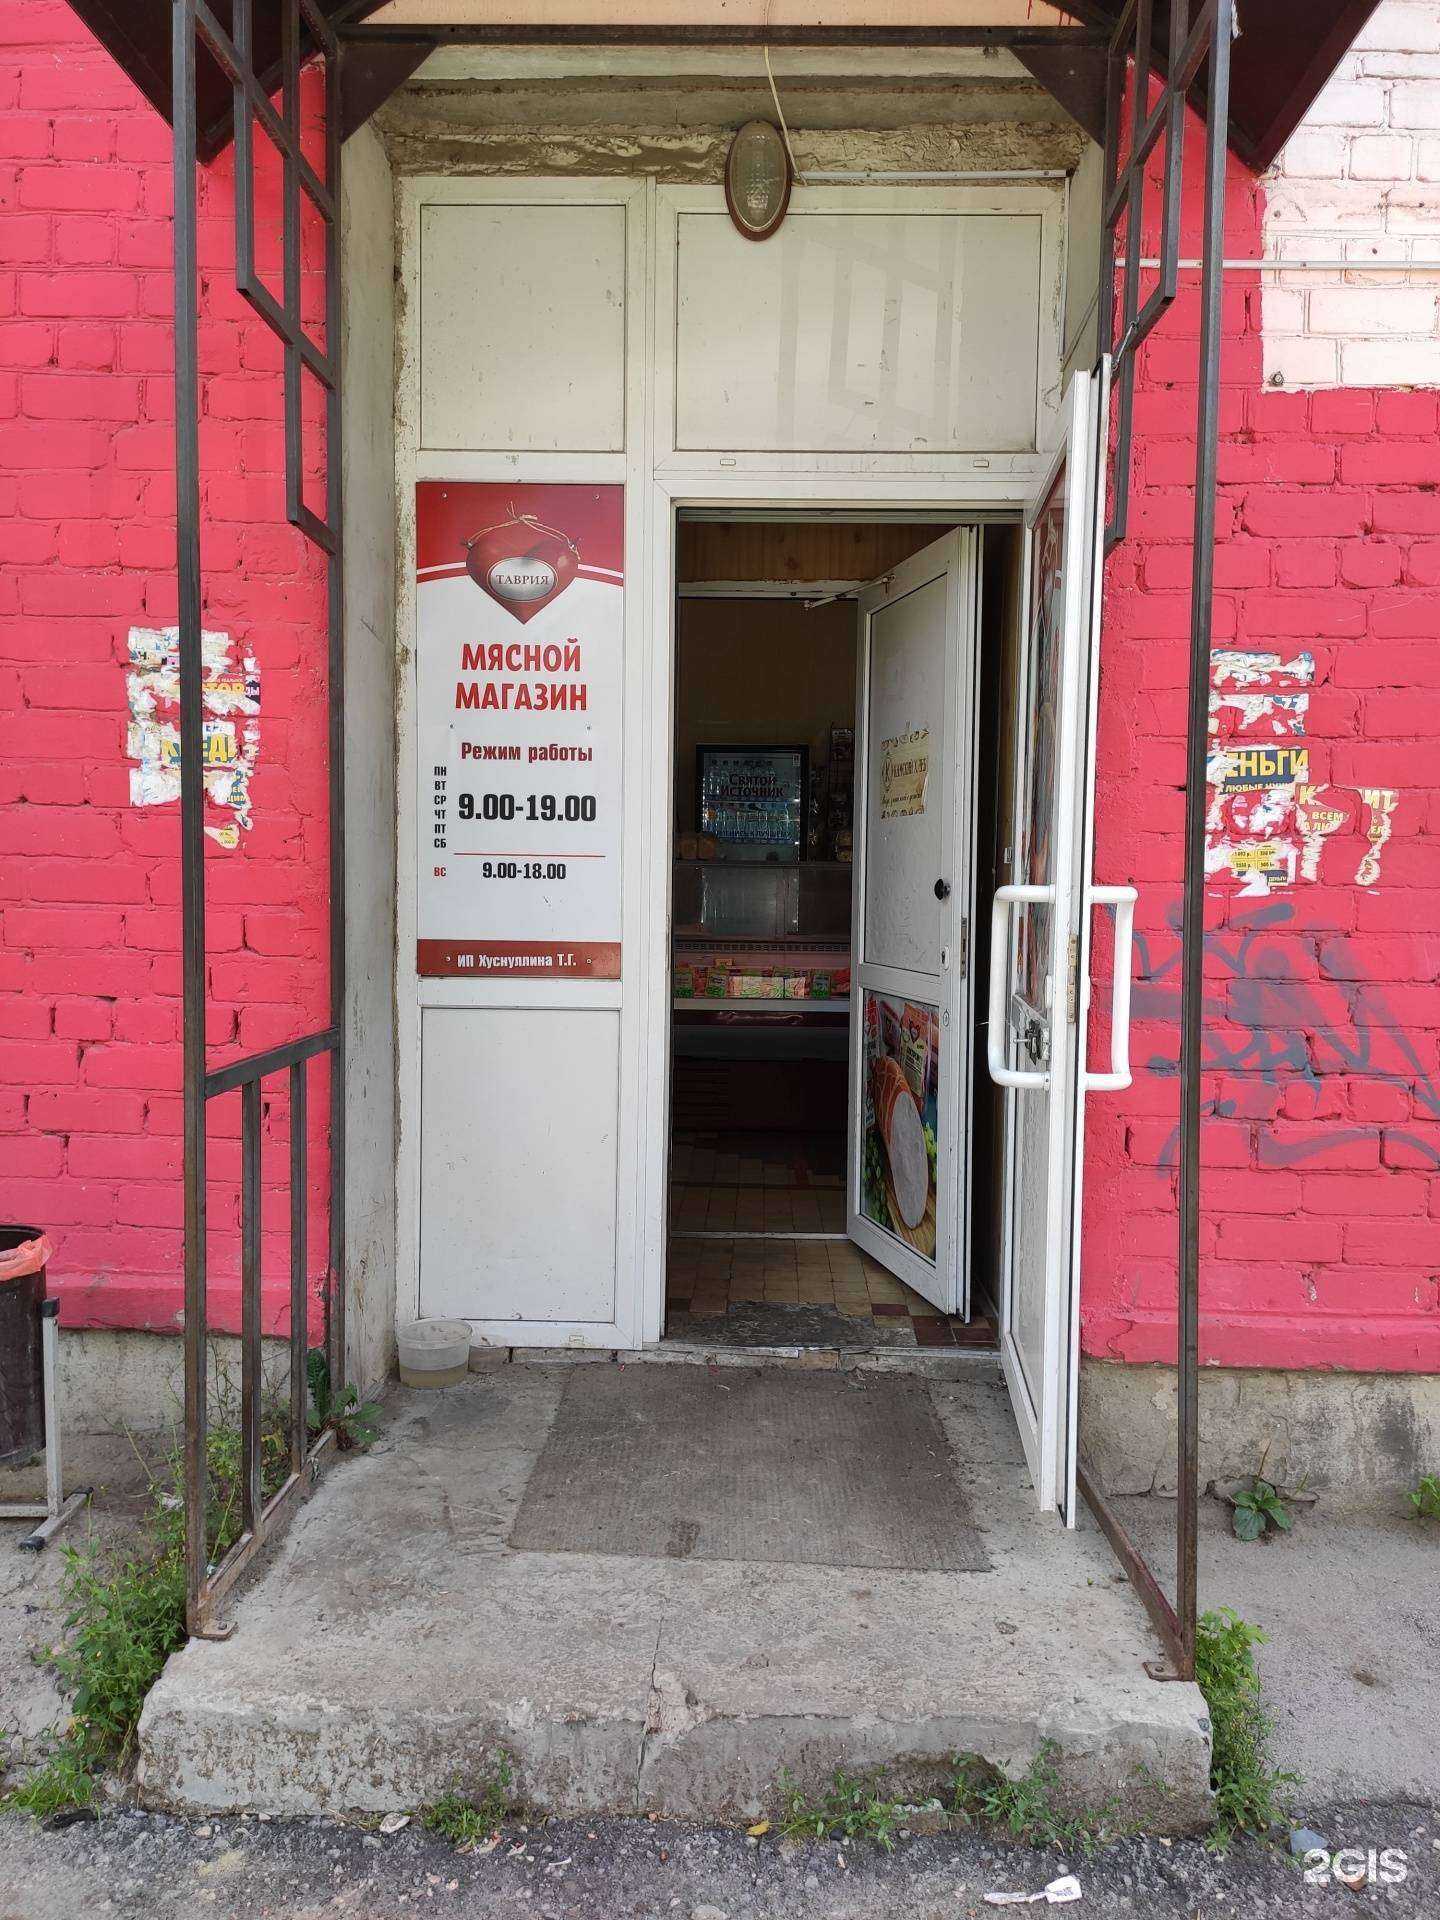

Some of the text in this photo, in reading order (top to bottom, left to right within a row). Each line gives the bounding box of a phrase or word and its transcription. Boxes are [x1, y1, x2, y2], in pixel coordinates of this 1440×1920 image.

[495, 574, 549, 585] ТАВРИЯ
[461, 637, 581, 672] МЯСНОЙ
[455, 682, 587, 711] МАГАЗИН
[461, 742, 593, 763] Режим работы
[434, 766, 447, 776] ПН
[434, 780, 447, 791] ВТ
[434, 795, 447, 805] СР
[458, 793, 597, 822] 9.00-19.00
[434, 809, 447, 820] ЧТ
[434, 823, 447, 834] ПТ
[434, 838, 447, 849] СБ
[433, 866, 447, 877] ВС
[482, 862, 567, 880] 9.00-18.00
[457, 953, 577, 969] ИП Хуснуллина Т.Г.
